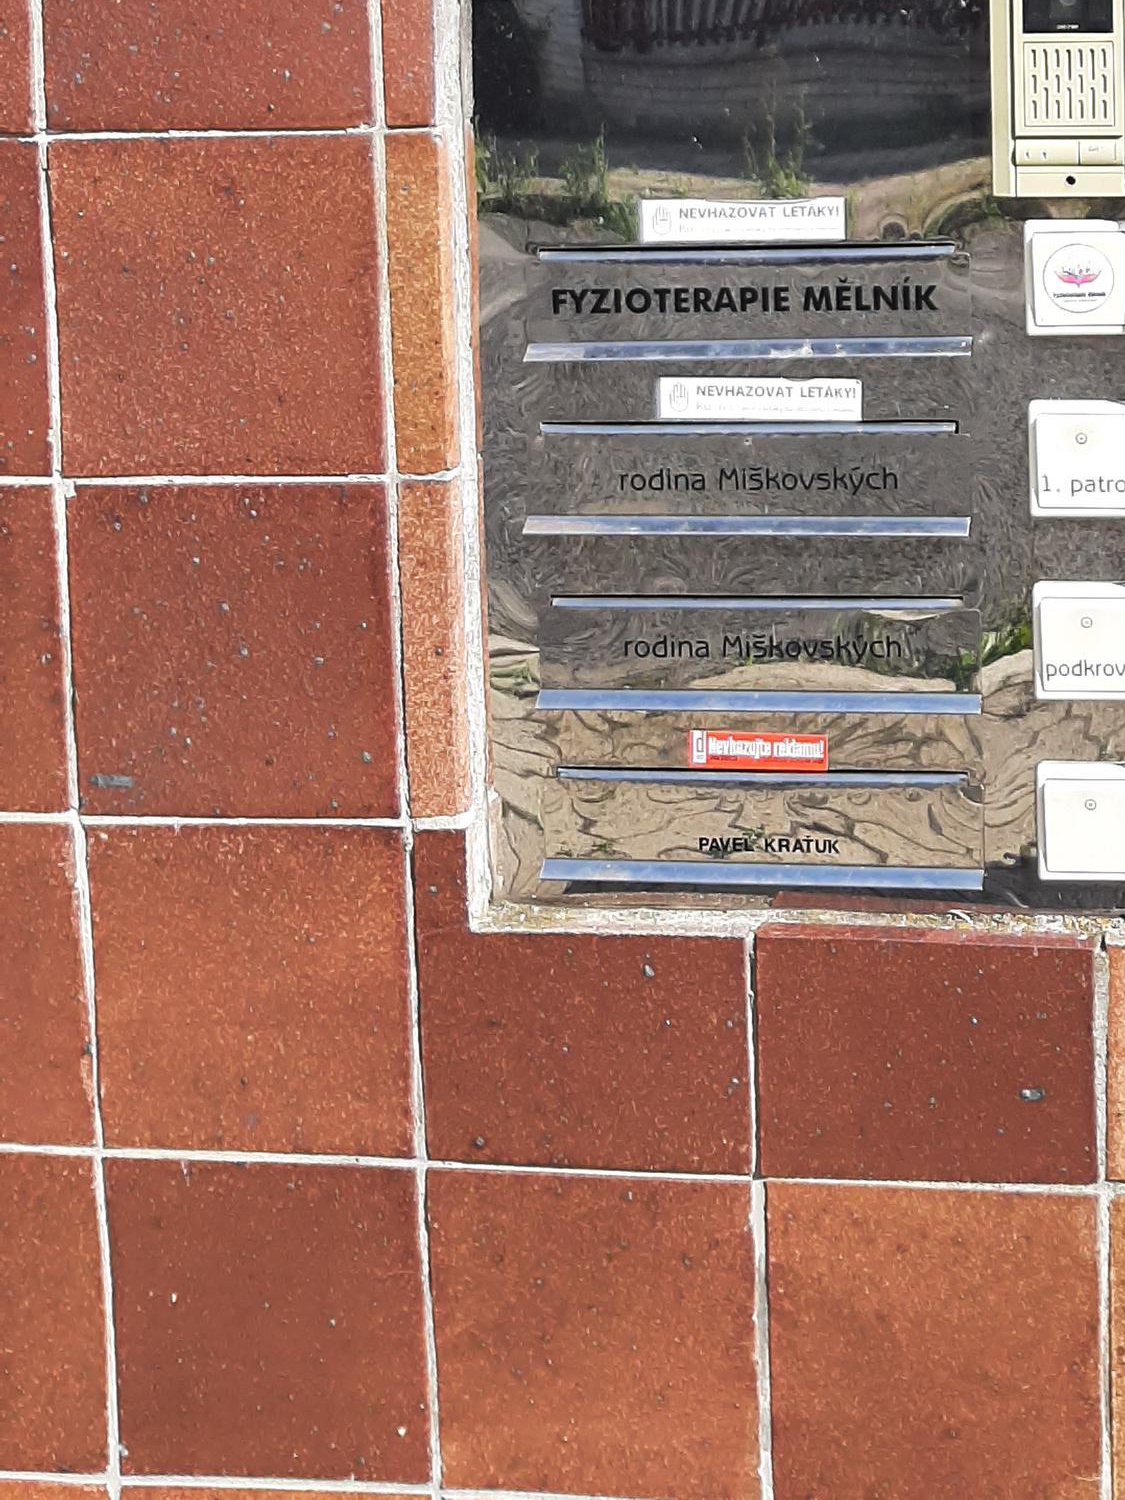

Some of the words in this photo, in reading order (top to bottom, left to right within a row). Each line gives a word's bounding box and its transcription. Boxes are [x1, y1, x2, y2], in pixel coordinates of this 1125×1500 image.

[679, 205, 777, 219] NEVHAZOVAT
[551, 286, 790, 314] FYZIOTERAPIE
[802, 276, 939, 312] MĚLNÍK
[696, 385, 794, 398] NEVHAZOVAT
[619, 467, 706, 491] rodina
[718, 466, 899, 496] Miškovských
[1041, 473, 1061, 493] 1.
[623, 634, 710, 658] rodina
[722, 633, 902, 665] Miškovských
[708, 735, 772, 760] Nevhazujte
[773, 737, 825, 759] reklamu!
[698, 836, 755, 852] PAVEL
[764, 834, 841, 854] KRAŤUK
